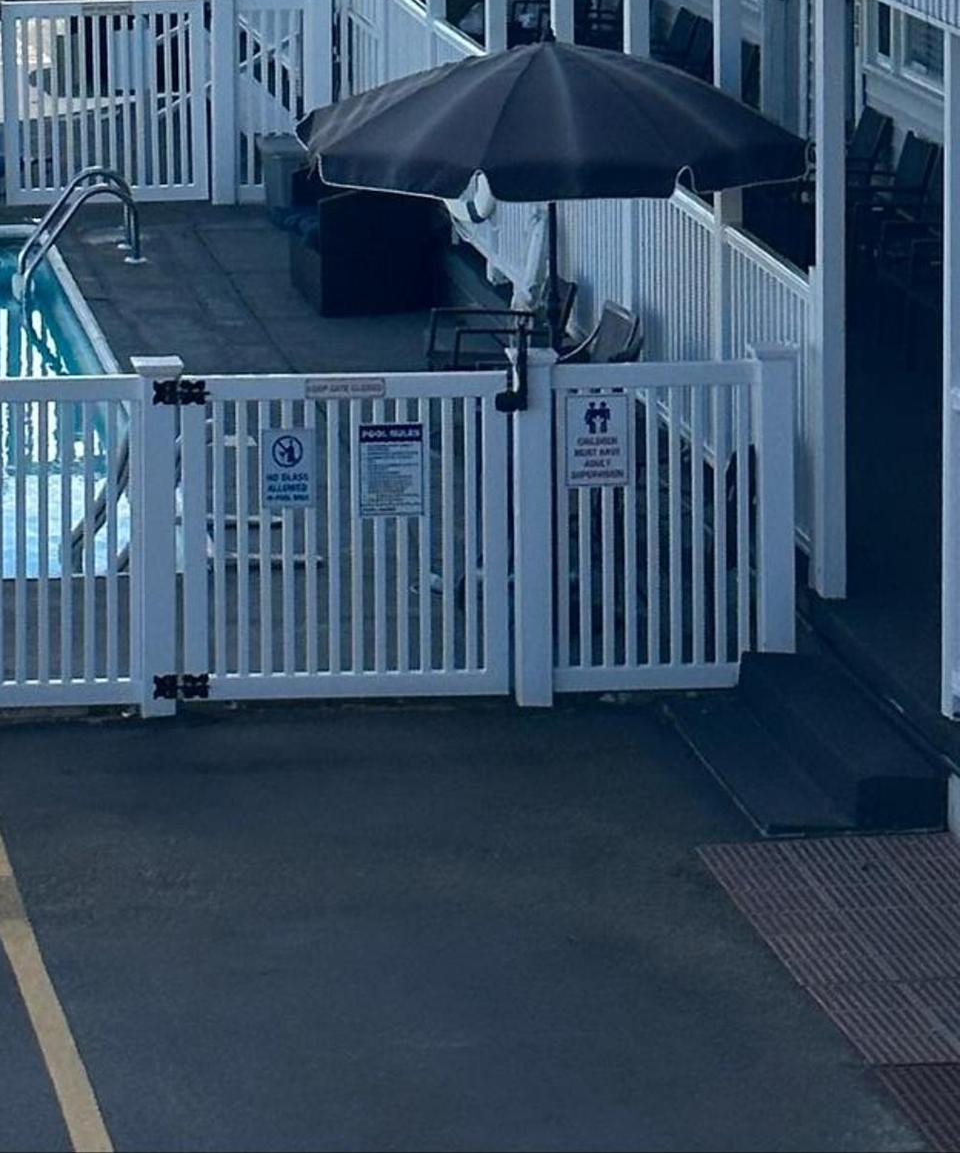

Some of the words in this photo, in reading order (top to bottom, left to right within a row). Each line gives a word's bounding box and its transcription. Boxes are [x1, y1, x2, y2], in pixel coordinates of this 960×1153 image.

[361, 429, 387, 439] POOL
[390, 429, 420, 438] RULES
[577, 436, 617, 446] CHILDREN
[574, 448, 597, 457] MUST
[599, 447, 620, 456] HAVE
[584, 458, 611, 468] ADULT
[266, 473, 278, 482] NO
[281, 472, 309, 482] GLASS
[267, 483, 308, 492] ALLOWED
